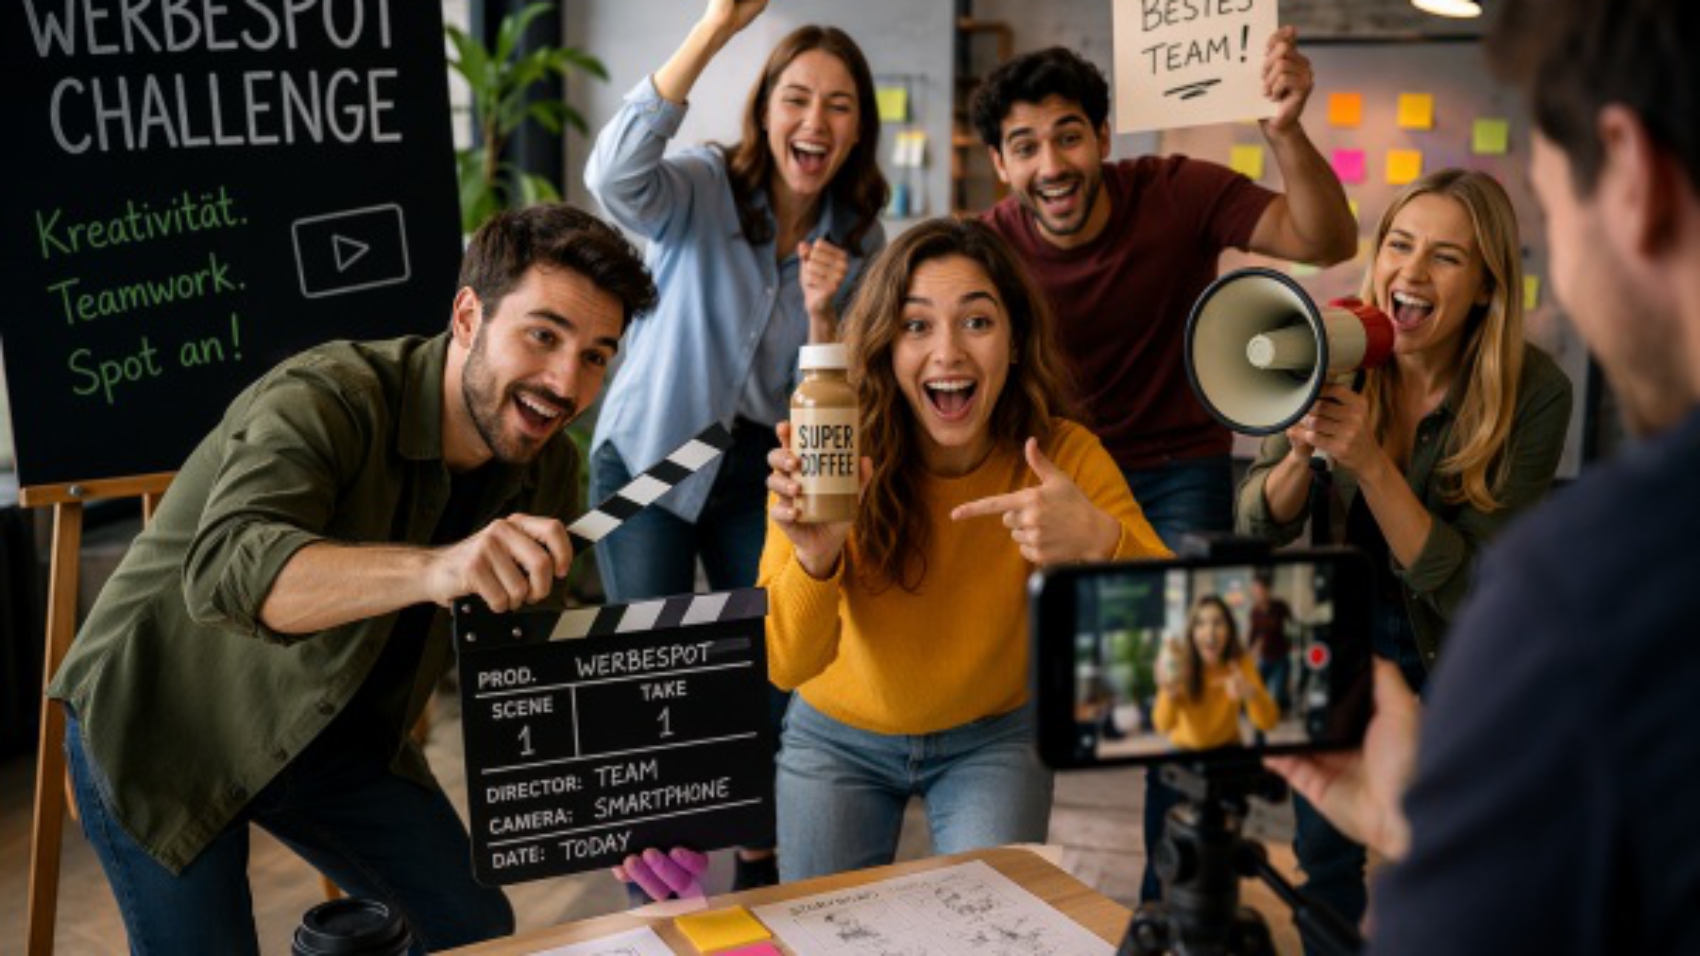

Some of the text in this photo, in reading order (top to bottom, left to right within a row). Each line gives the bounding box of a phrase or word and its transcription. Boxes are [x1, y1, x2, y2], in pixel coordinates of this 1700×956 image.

[23, 0, 391, 57] WERBESPOT
[1141, 25, 1249, 75] TEAM!
[49, 69, 402, 154] CHALLENGE
[35, 185, 248, 259] Kreativität.
[47, 252, 246, 325] Teamwork.
[68, 313, 243, 404] Spot an!
[799, 425, 853, 449] SUPER
[477, 641, 715, 689] PROD. WERBESPOT
[491, 696, 554, 720] SCENE
[640, 680, 688, 701] TAKE
[517, 724, 535, 756] 1
[657, 706, 675, 738] 1
[485, 759, 659, 804] DIRECTOR: TEAM
[488, 776, 731, 835] CAMERA: SMARTPHONE
[491, 831, 633, 870] DATE: TODAY
